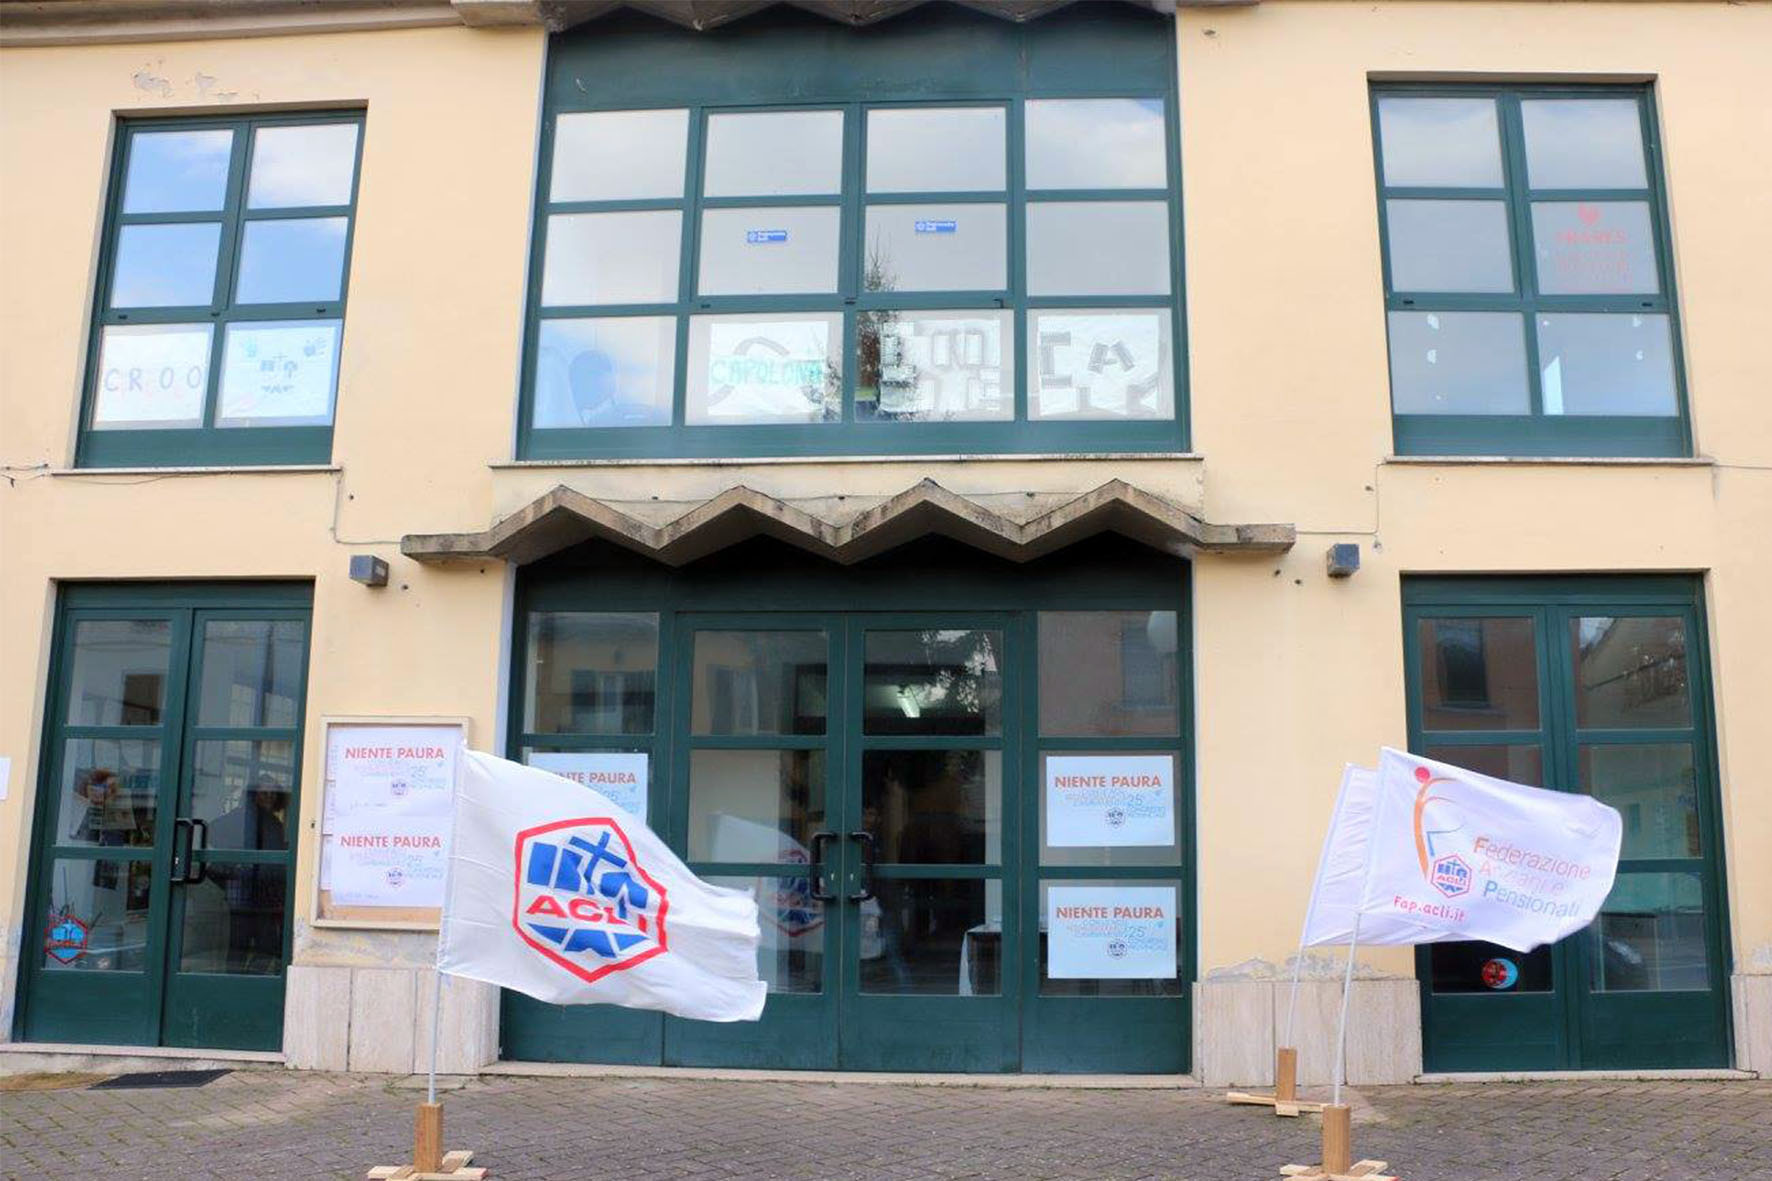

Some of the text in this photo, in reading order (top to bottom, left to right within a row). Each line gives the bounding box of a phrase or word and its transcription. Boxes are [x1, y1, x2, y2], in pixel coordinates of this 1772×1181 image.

[345, 748, 444, 759] NIENTE PAURA
[589, 772, 635, 783] PAURA
[1055, 775, 1161, 788] NIENTE PAURA
[340, 836, 441, 848] NIENTE PAURA
[1474, 836, 1590, 880] Federazione
[1483, 880, 1580, 917] Pensionati
[526, 895, 647, 934] ACLI
[1056, 907, 1164, 919] NIENTE PAURA
[1394, 896, 1465, 920] Fap.acli.it
